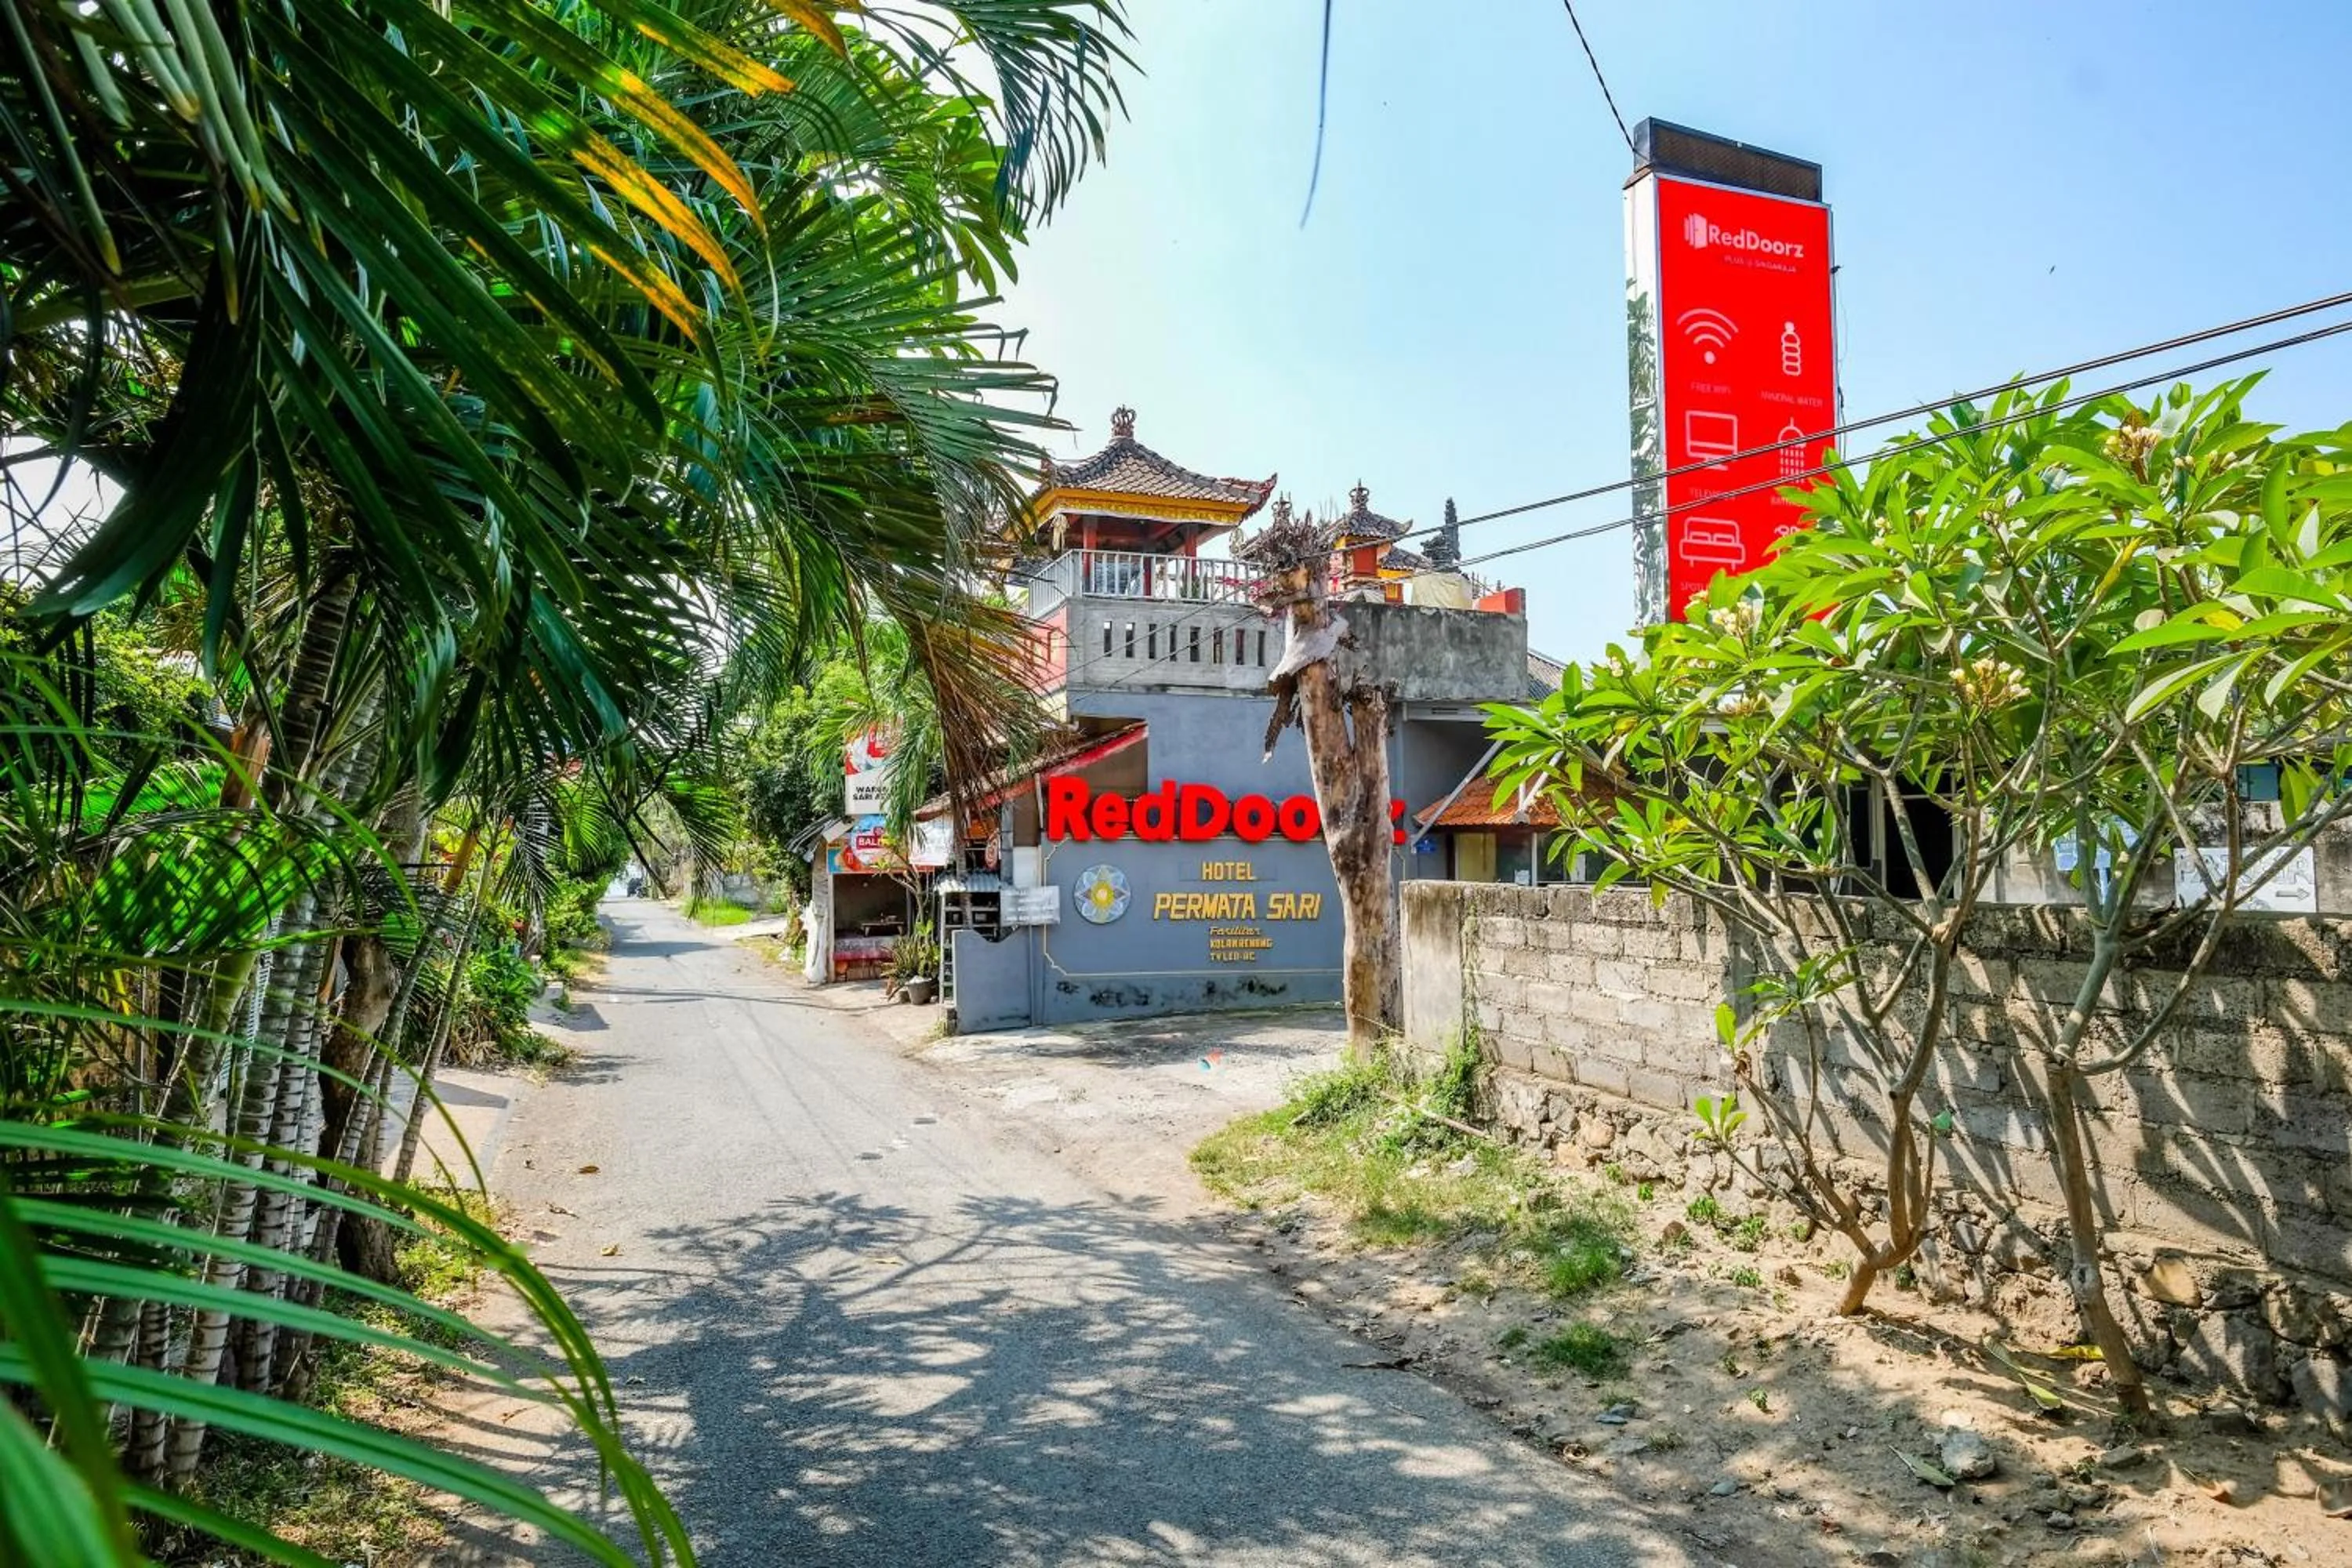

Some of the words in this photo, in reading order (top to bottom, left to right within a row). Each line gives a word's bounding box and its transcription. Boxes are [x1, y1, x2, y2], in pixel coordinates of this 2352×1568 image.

[1708, 223, 1804, 258] RedDoorz
[1690, 381, 1711, 394] FREE
[1761, 390, 1795, 404] MINERAL
[1797, 397, 1824, 408] WATER
[1047, 775, 1407, 844] RedDoo
[1202, 862, 1257, 880] HOTEL
[1153, 892, 1255, 920] PERMATA
[1266, 892, 1321, 920] SARI
